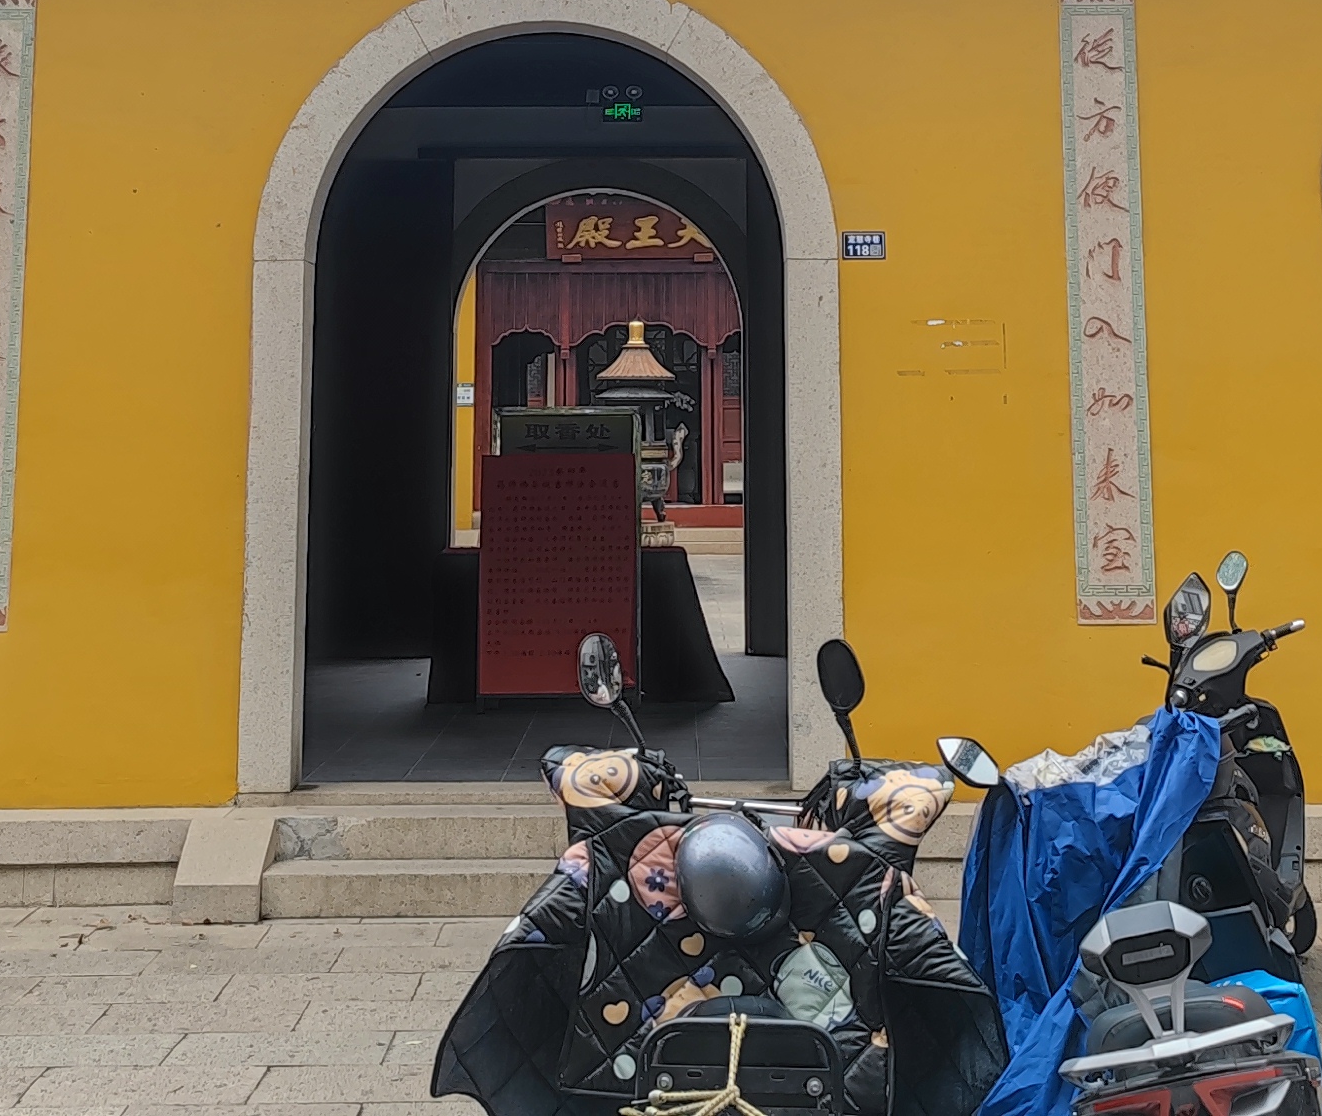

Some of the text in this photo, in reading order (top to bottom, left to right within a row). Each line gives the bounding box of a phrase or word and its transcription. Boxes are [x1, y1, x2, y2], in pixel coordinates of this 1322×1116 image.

[847, 245, 870, 256] 118
[524, 423, 611, 441] 取香处
[803, 968, 833, 993] Nice
